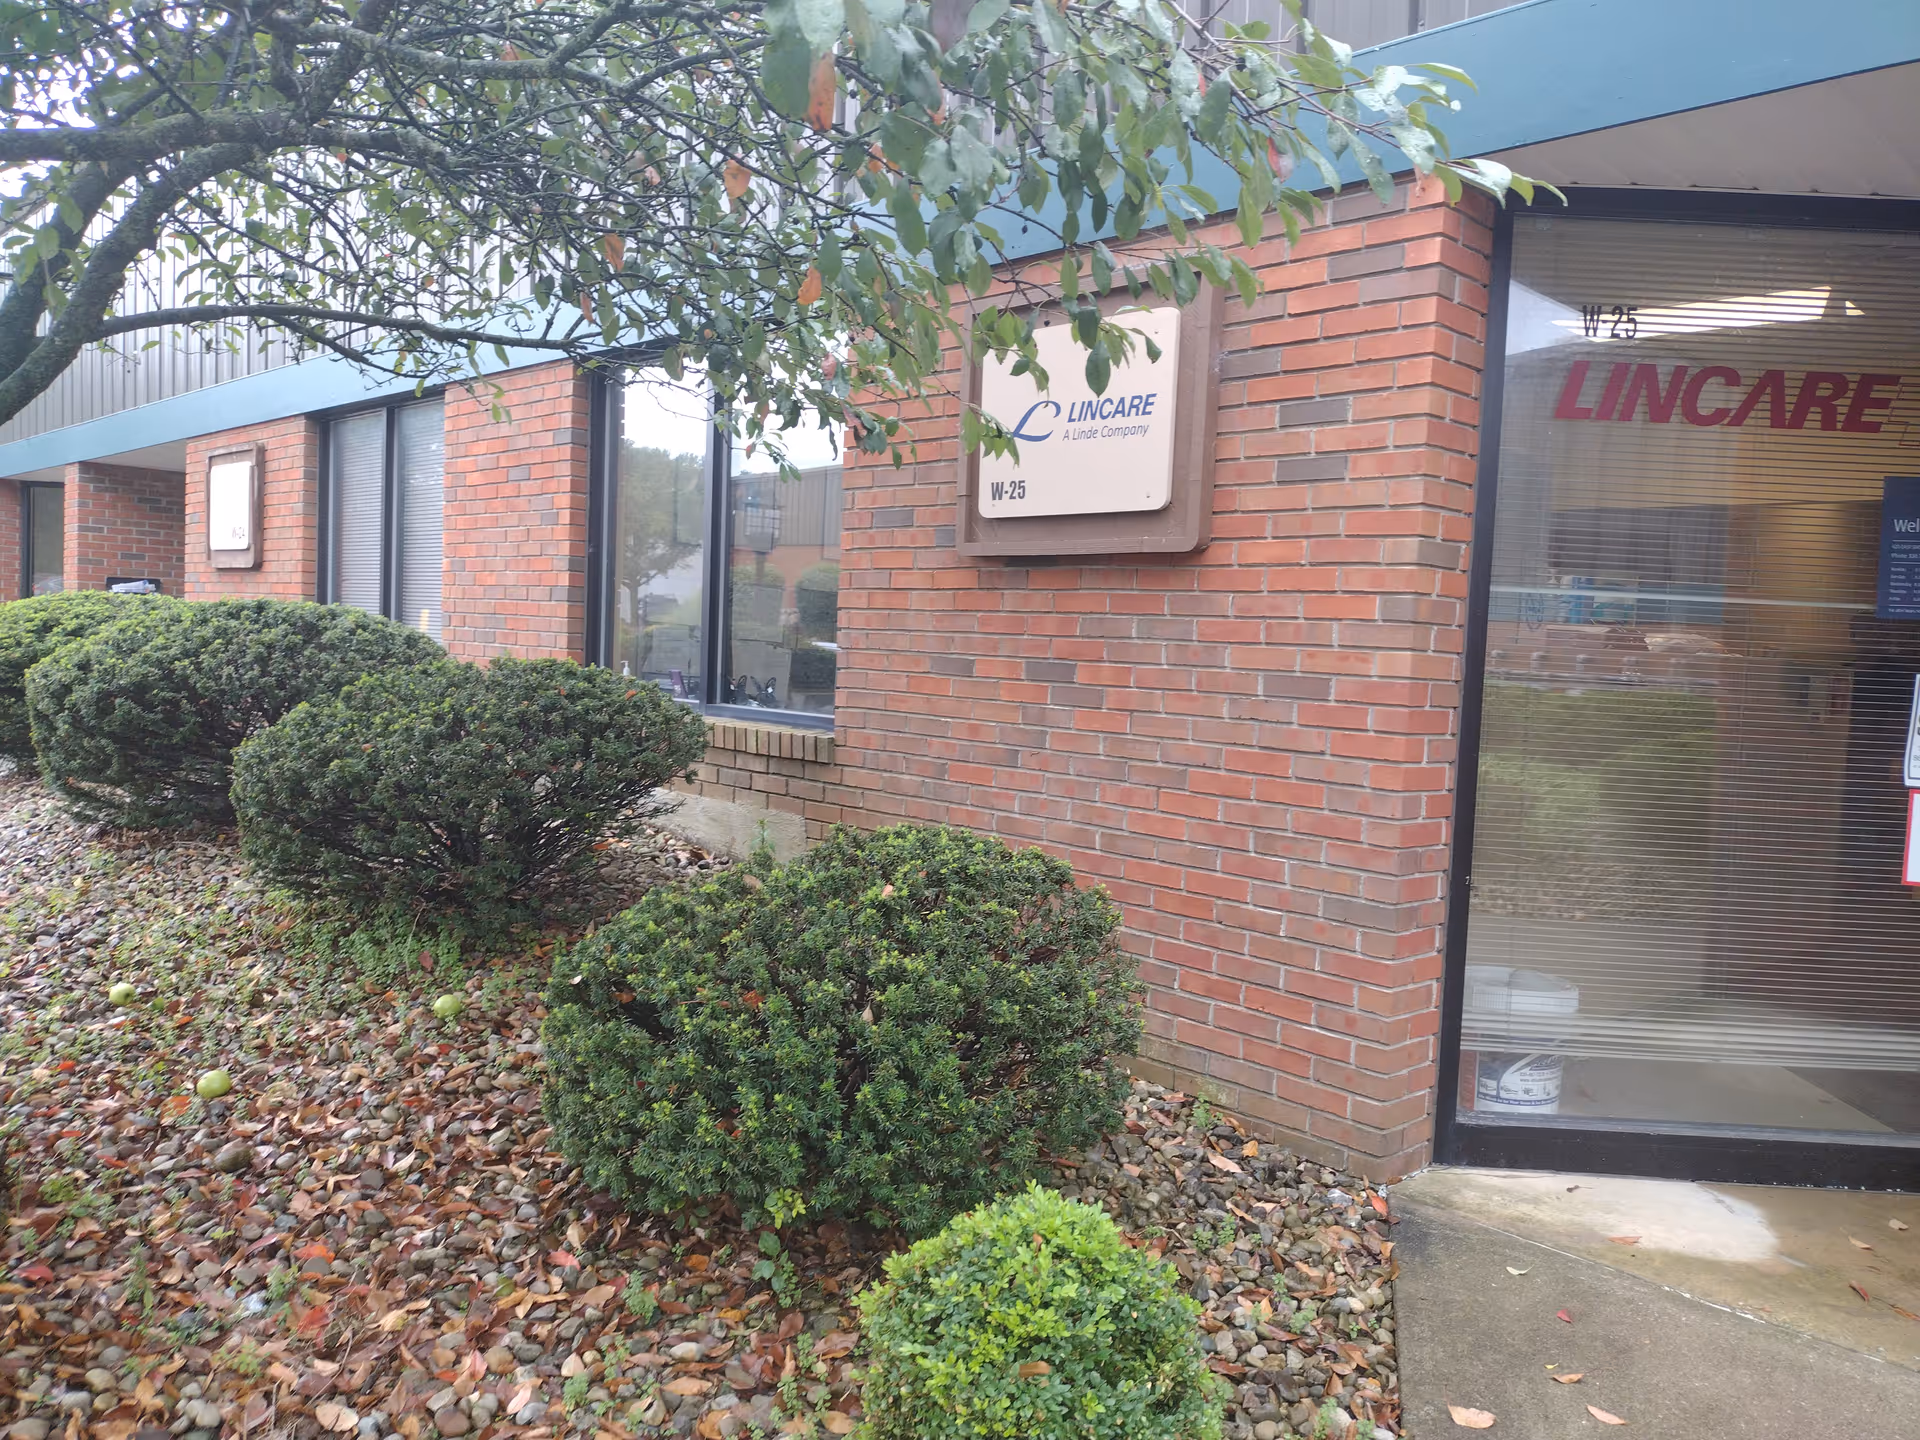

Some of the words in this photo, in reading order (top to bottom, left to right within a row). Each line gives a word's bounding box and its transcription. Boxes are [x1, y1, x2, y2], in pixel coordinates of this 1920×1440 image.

[1582, 305, 1637, 339] W-25
[1067, 393, 1157, 422] LINCARE
[1554, 360, 1901, 433] LINCARE
[1062, 429, 1070, 441] A
[1072, 426, 1098, 441] Linde
[1100, 425, 1149, 439] Company
[991, 480, 1026, 501] W-25
